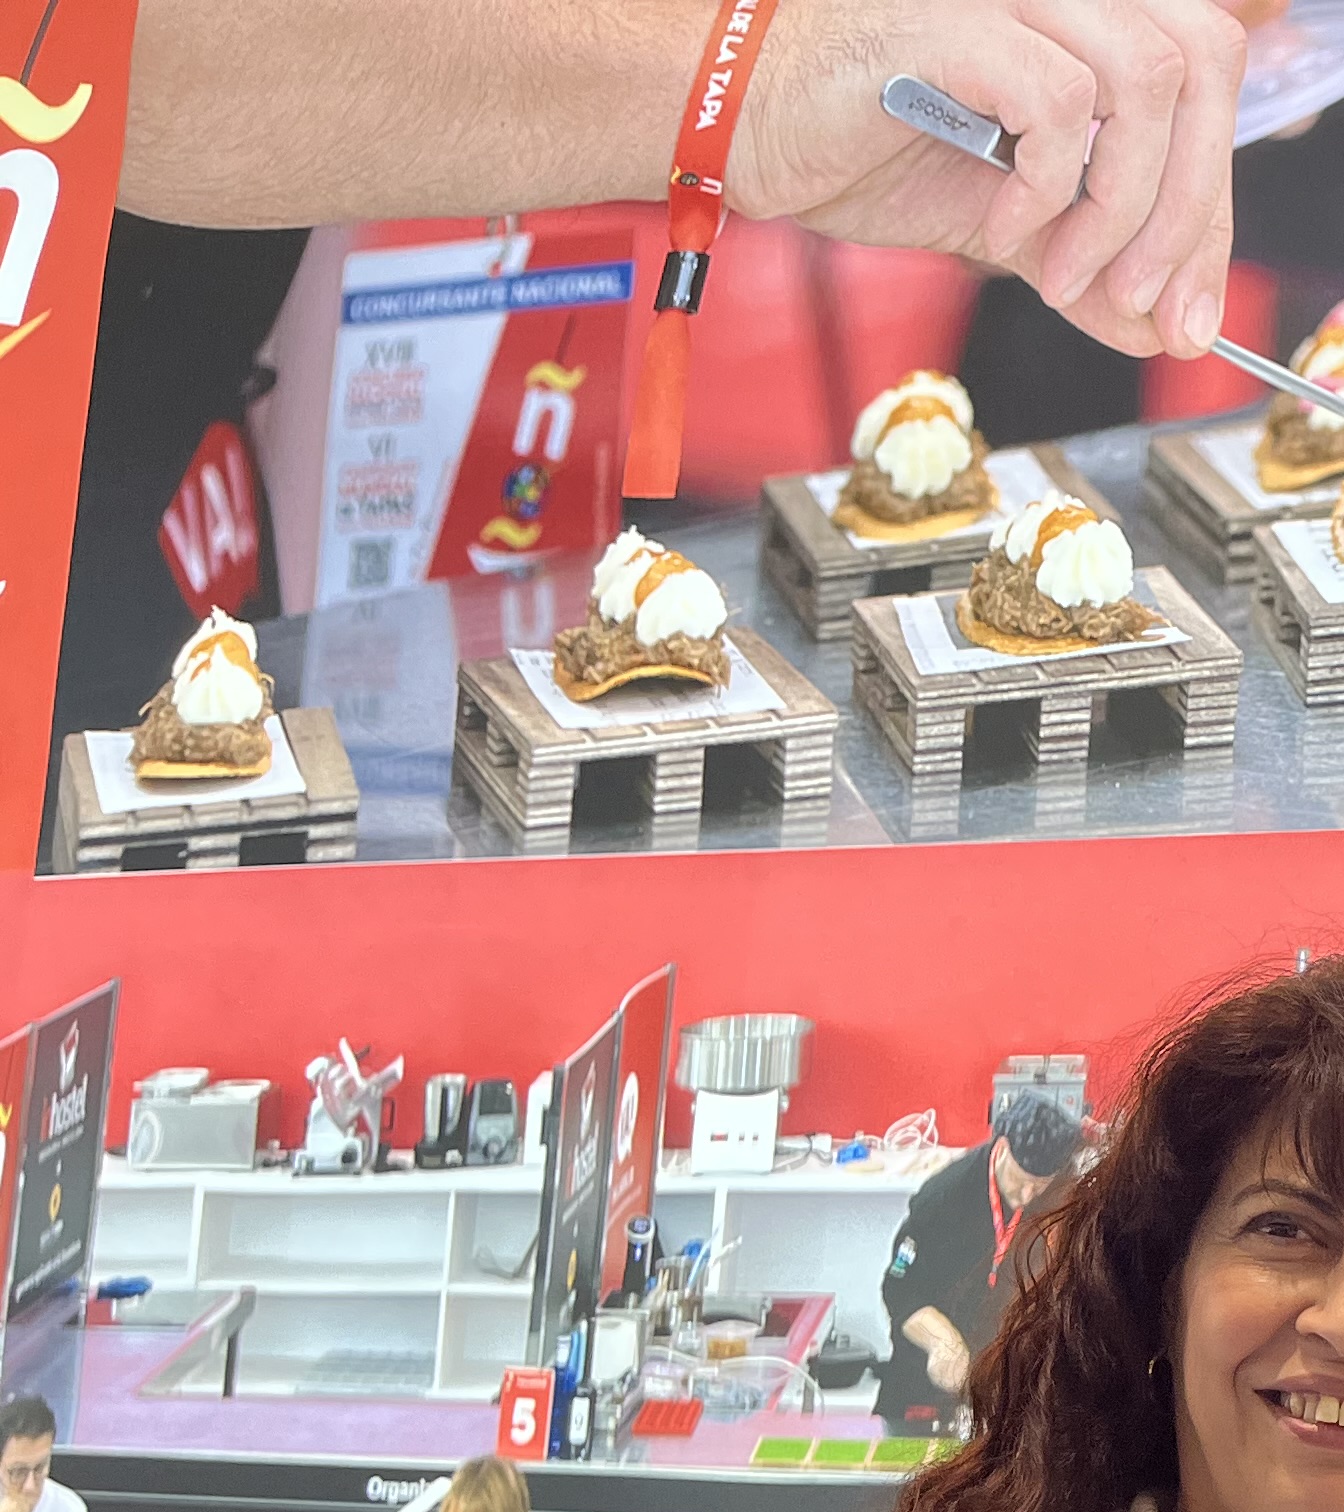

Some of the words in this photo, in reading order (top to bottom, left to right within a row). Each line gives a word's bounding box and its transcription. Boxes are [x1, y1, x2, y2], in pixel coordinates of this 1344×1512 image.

[727, 11, 753, 34] DE
[716, 34, 744, 64] LA
[695, 69, 733, 131] TAPA
[510, 1397, 537, 1445] 5
[366, 1474, 428, 1504] Organi
